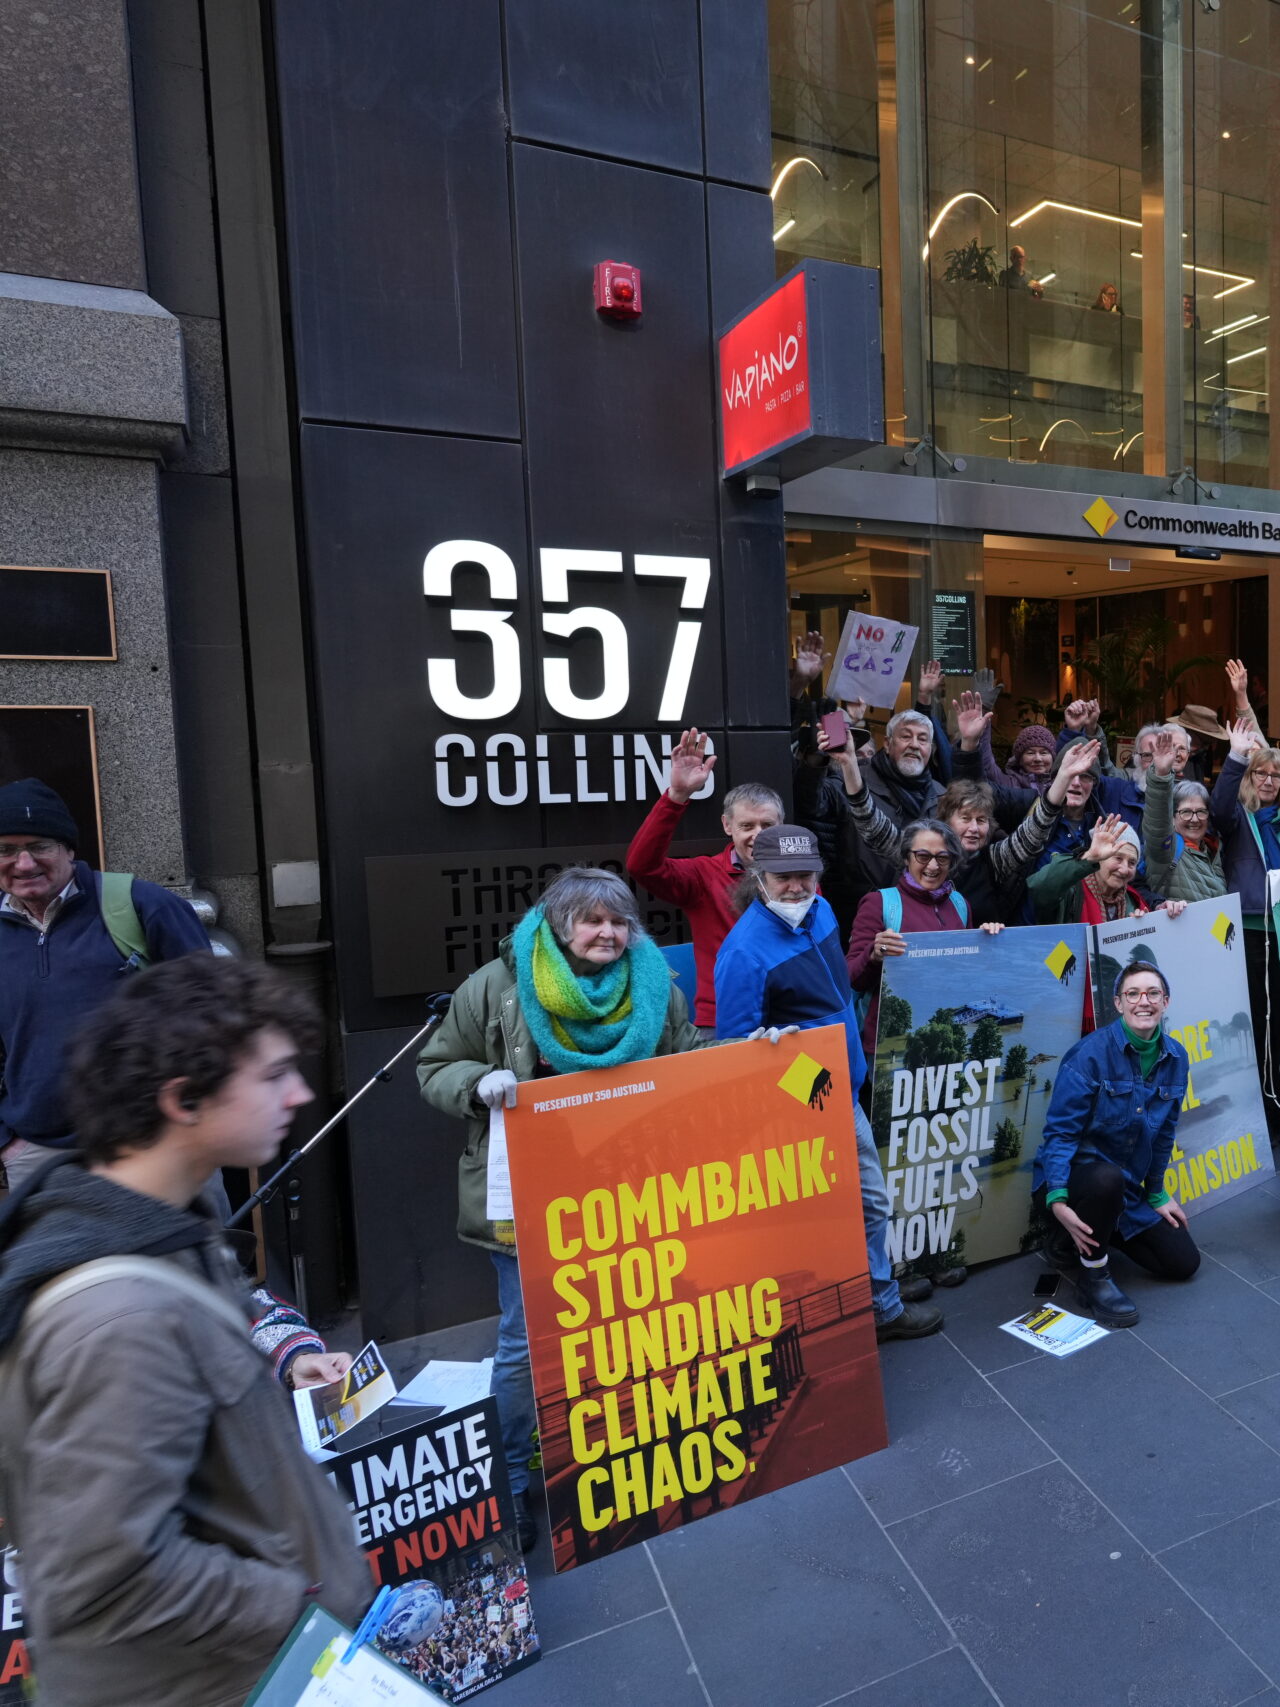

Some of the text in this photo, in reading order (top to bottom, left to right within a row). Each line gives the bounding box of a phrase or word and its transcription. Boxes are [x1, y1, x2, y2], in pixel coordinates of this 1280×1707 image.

[1124, 509, 1260, 539] Commonwealth
[423, 540, 711, 721] 357
[856, 623, 885, 643] NO
[843, 652, 894, 676] GAS
[533, 1079, 656, 1114] PRESENTED BY 350 AUSTRALIA
[890, 1057, 1001, 1118] DIVEST
[887, 1105, 995, 1168] FOSSIL
[545, 1136, 837, 1261] COMMBANK:
[886, 1154, 980, 1217] FUELS
[885, 1205, 957, 1266] NOW.
[552, 1238, 688, 1329] STOP
[560, 1277, 783, 1400] FUNDING
[568, 1341, 779, 1465] CLIMATE
[576, 1418, 758, 1532] CHAOS.
[393, 1495, 502, 1577] NOW!
